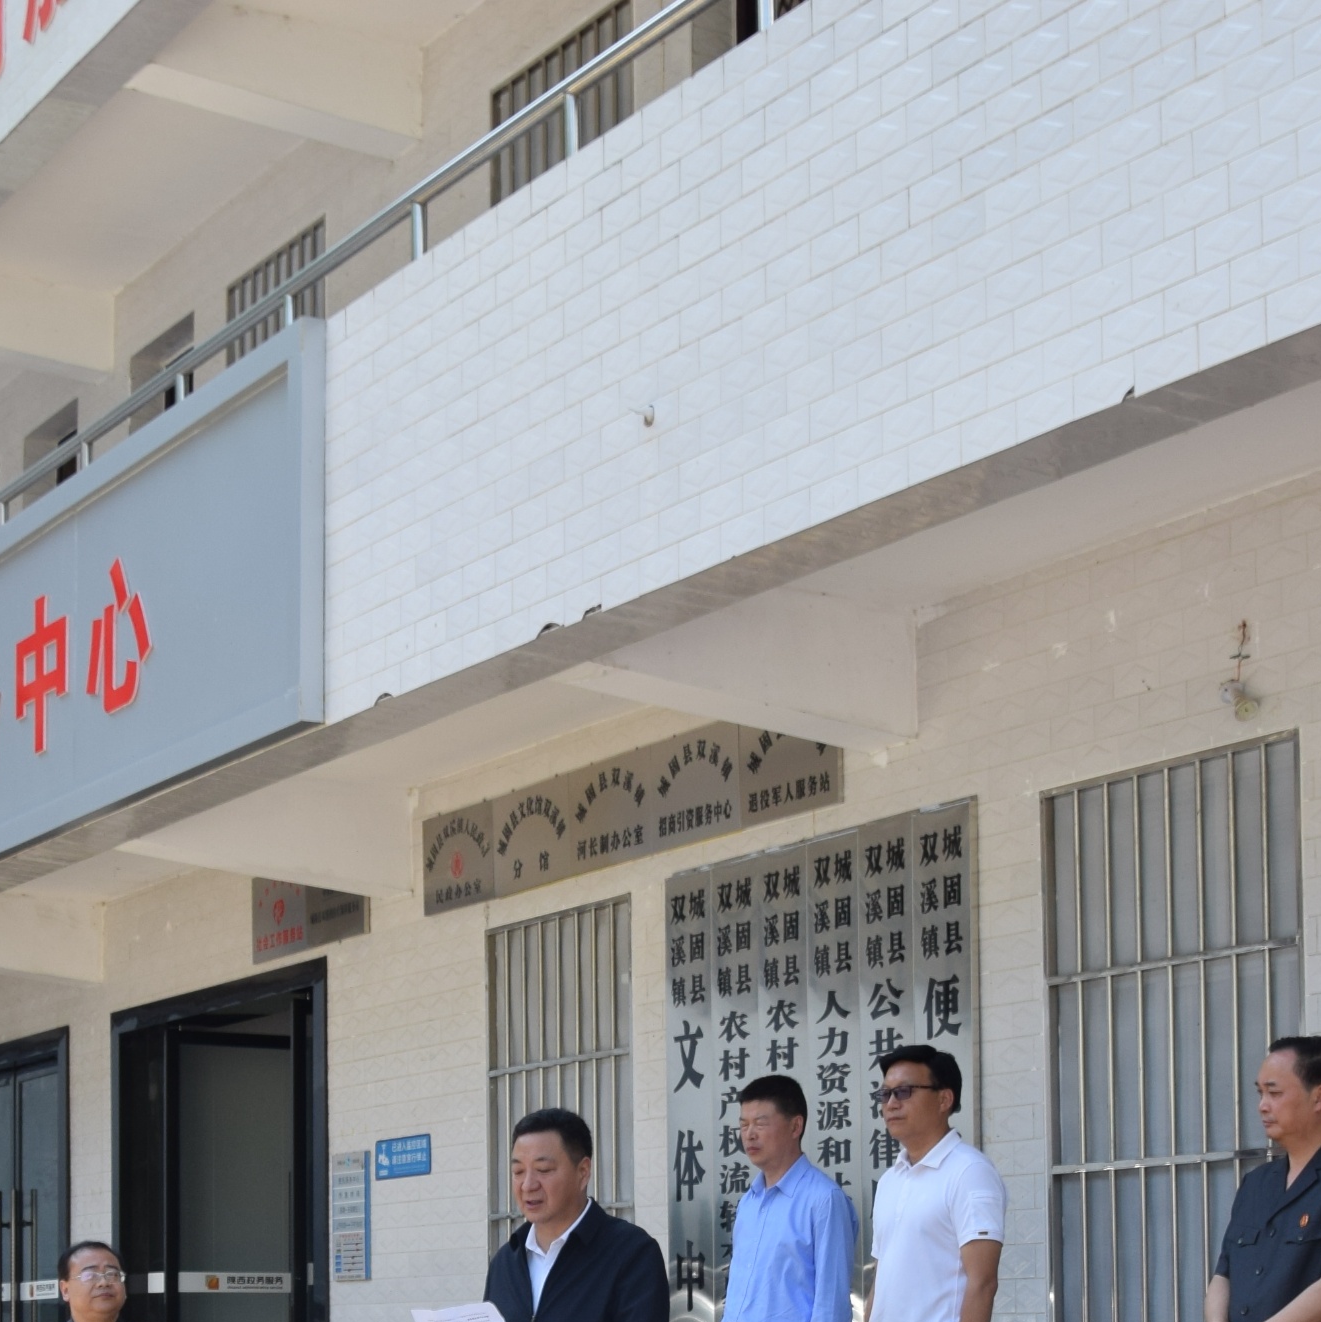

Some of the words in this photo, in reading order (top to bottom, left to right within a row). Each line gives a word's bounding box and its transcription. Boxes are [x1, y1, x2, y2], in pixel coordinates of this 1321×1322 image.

[575, 767, 646, 825] 城固县双溪镇
[657, 739, 733, 799] 城固县双溪镇
[658, 798, 733, 838] 招商引资服务中心
[747, 771, 831, 814] 退役军人服务站
[576, 823, 644, 861] 河长制办公室
[919, 832, 940, 961] 双溪镇
[942, 825, 964, 956] 城固县
[670, 894, 686, 1009] 双溪镇
[688, 888, 706, 1005] 城固县
[716, 882, 733, 999] 双溪镇
[735, 876, 752, 996] 城固县
[763, 870, 780, 991] 双溪镇
[783, 866, 801, 988] 城固县
[813, 856, 831, 978] 双溪镇
[834, 849, 853, 975] 城固县
[865, 844, 883, 971] 双溪镇
[886, 837, 906, 965] 城固县
[922, 973, 964, 1041] 便
[226, 1276, 284, 1285] 陕西政务服务
